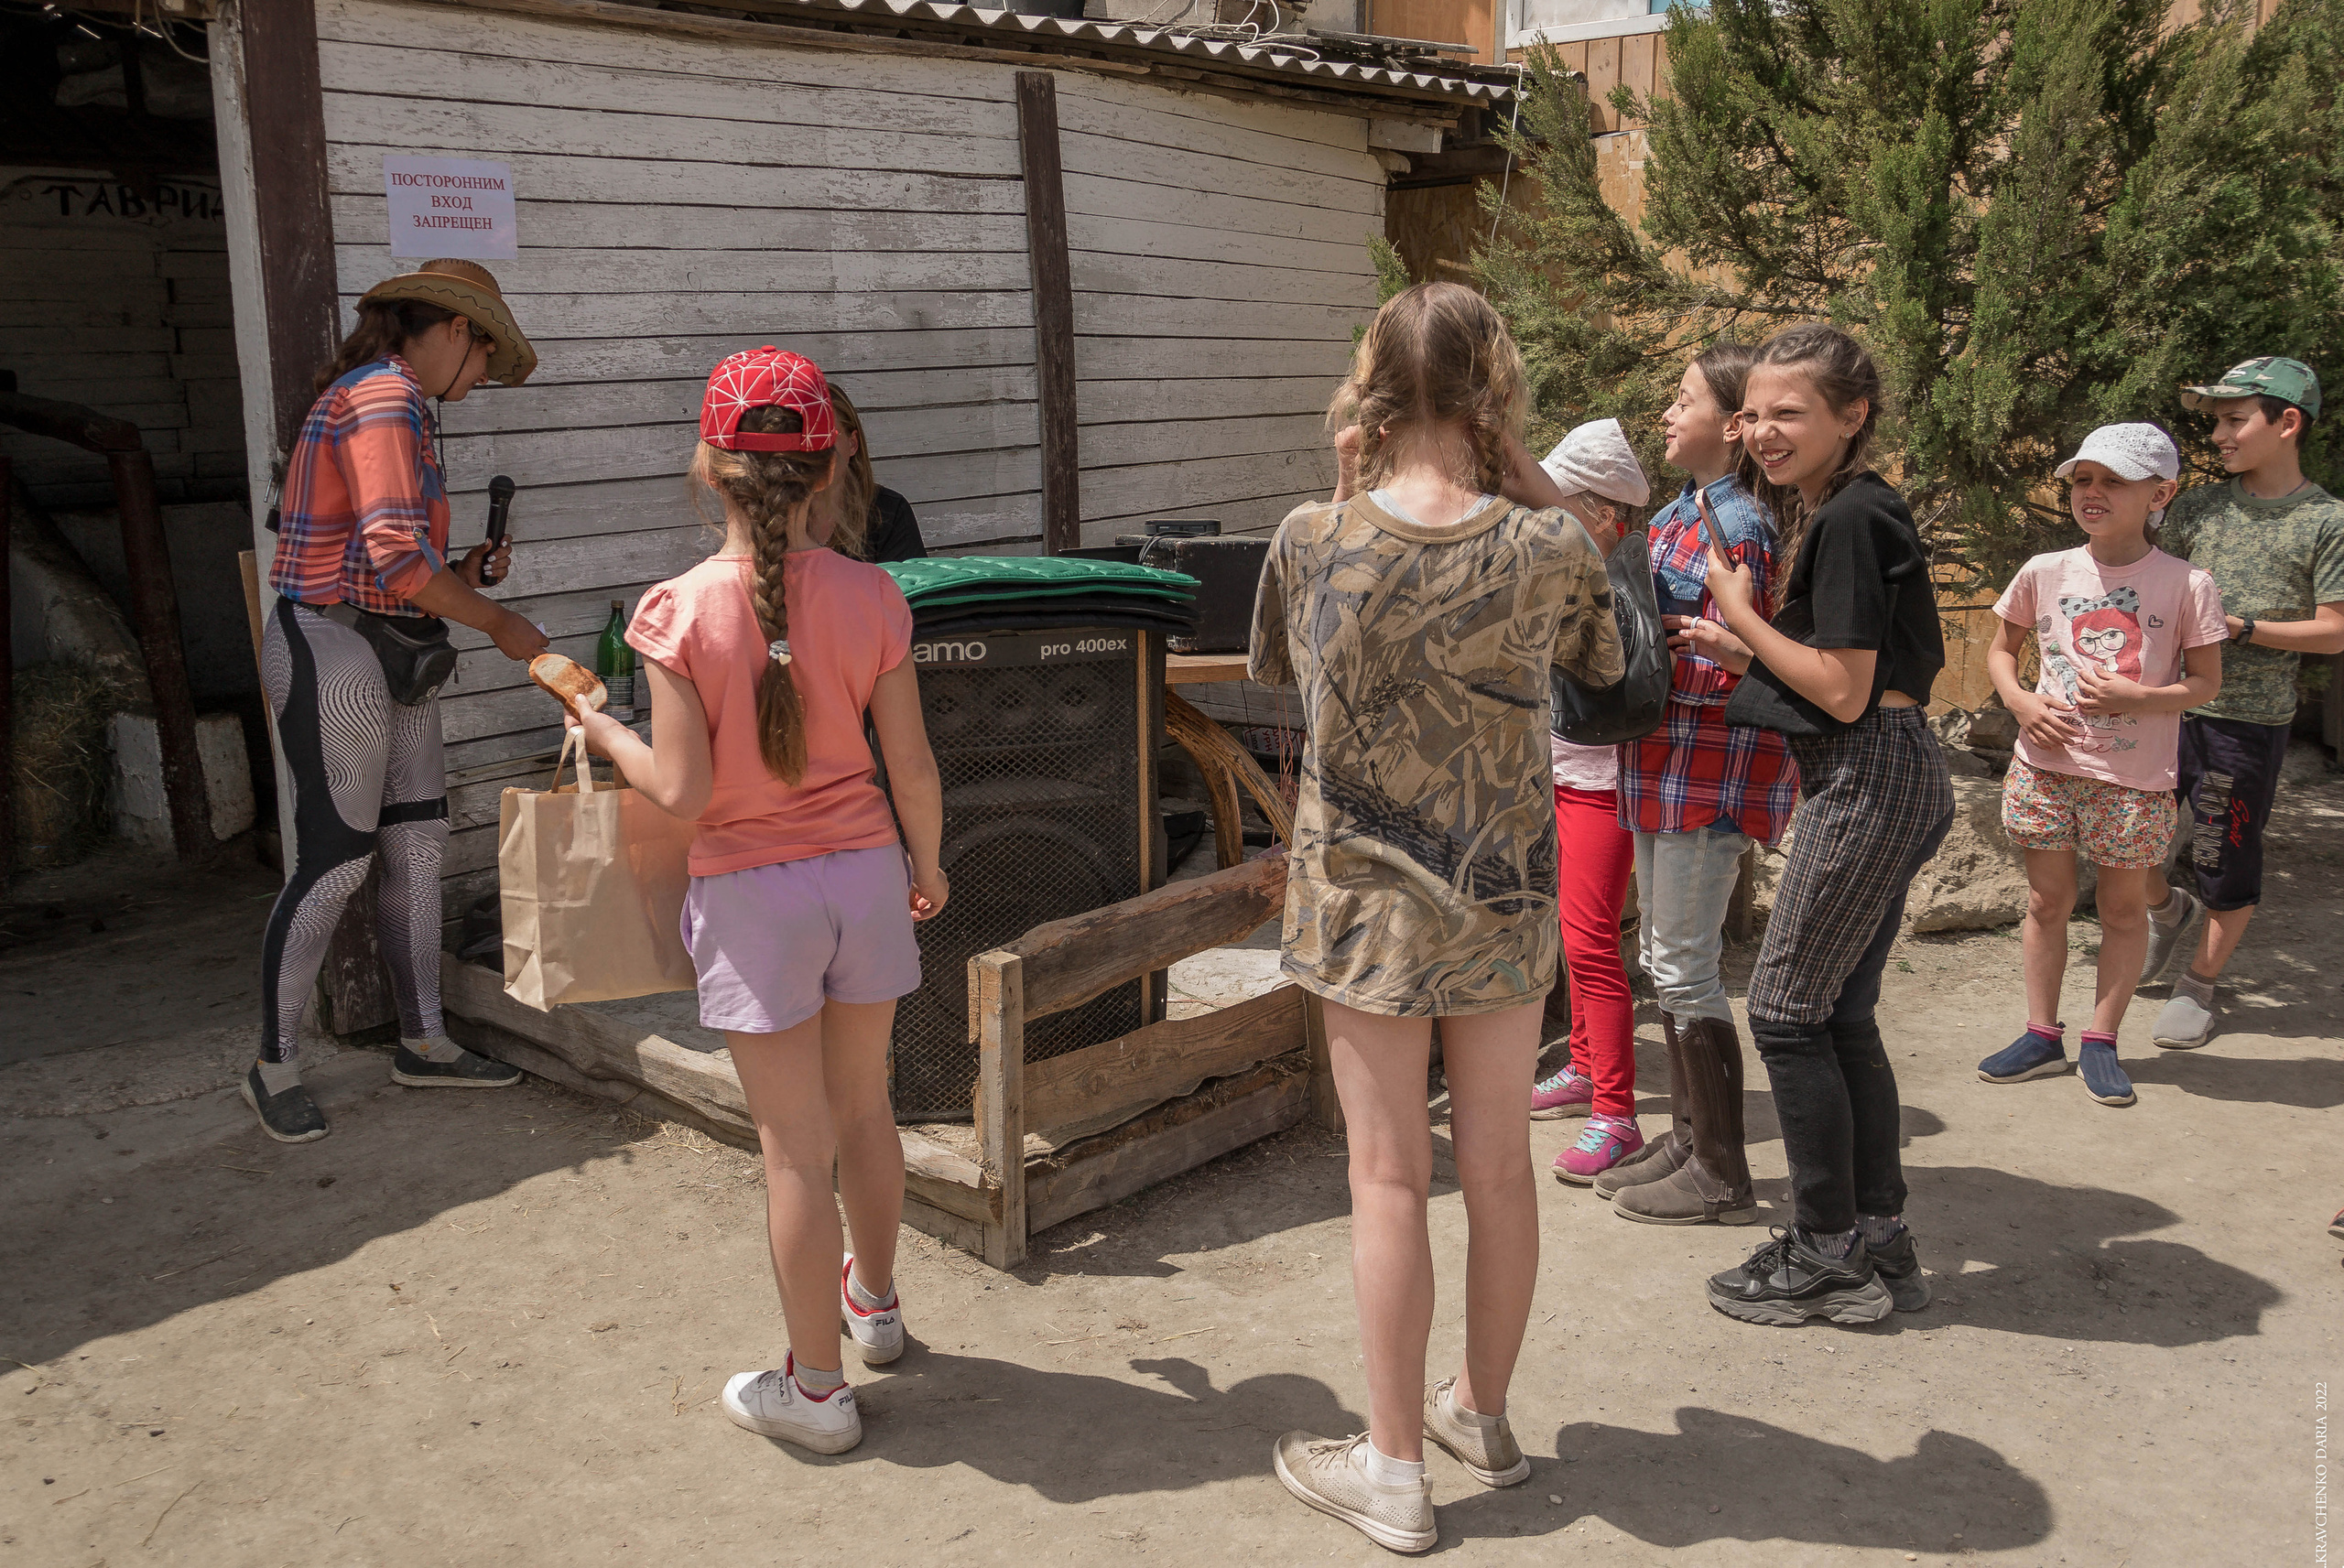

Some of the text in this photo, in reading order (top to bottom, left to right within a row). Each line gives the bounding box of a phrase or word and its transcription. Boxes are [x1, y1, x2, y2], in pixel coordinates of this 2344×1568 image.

[391, 173, 505, 190] ПОСТОРОННИМ
[430, 195, 473, 211] ВХОД
[413, 215, 494, 232] ЗАПРЕЩЕН
[1040, 642, 1071, 660] pro
[1076, 638, 1127, 654] 400ex
[875, 1316, 895, 1327] FILA
